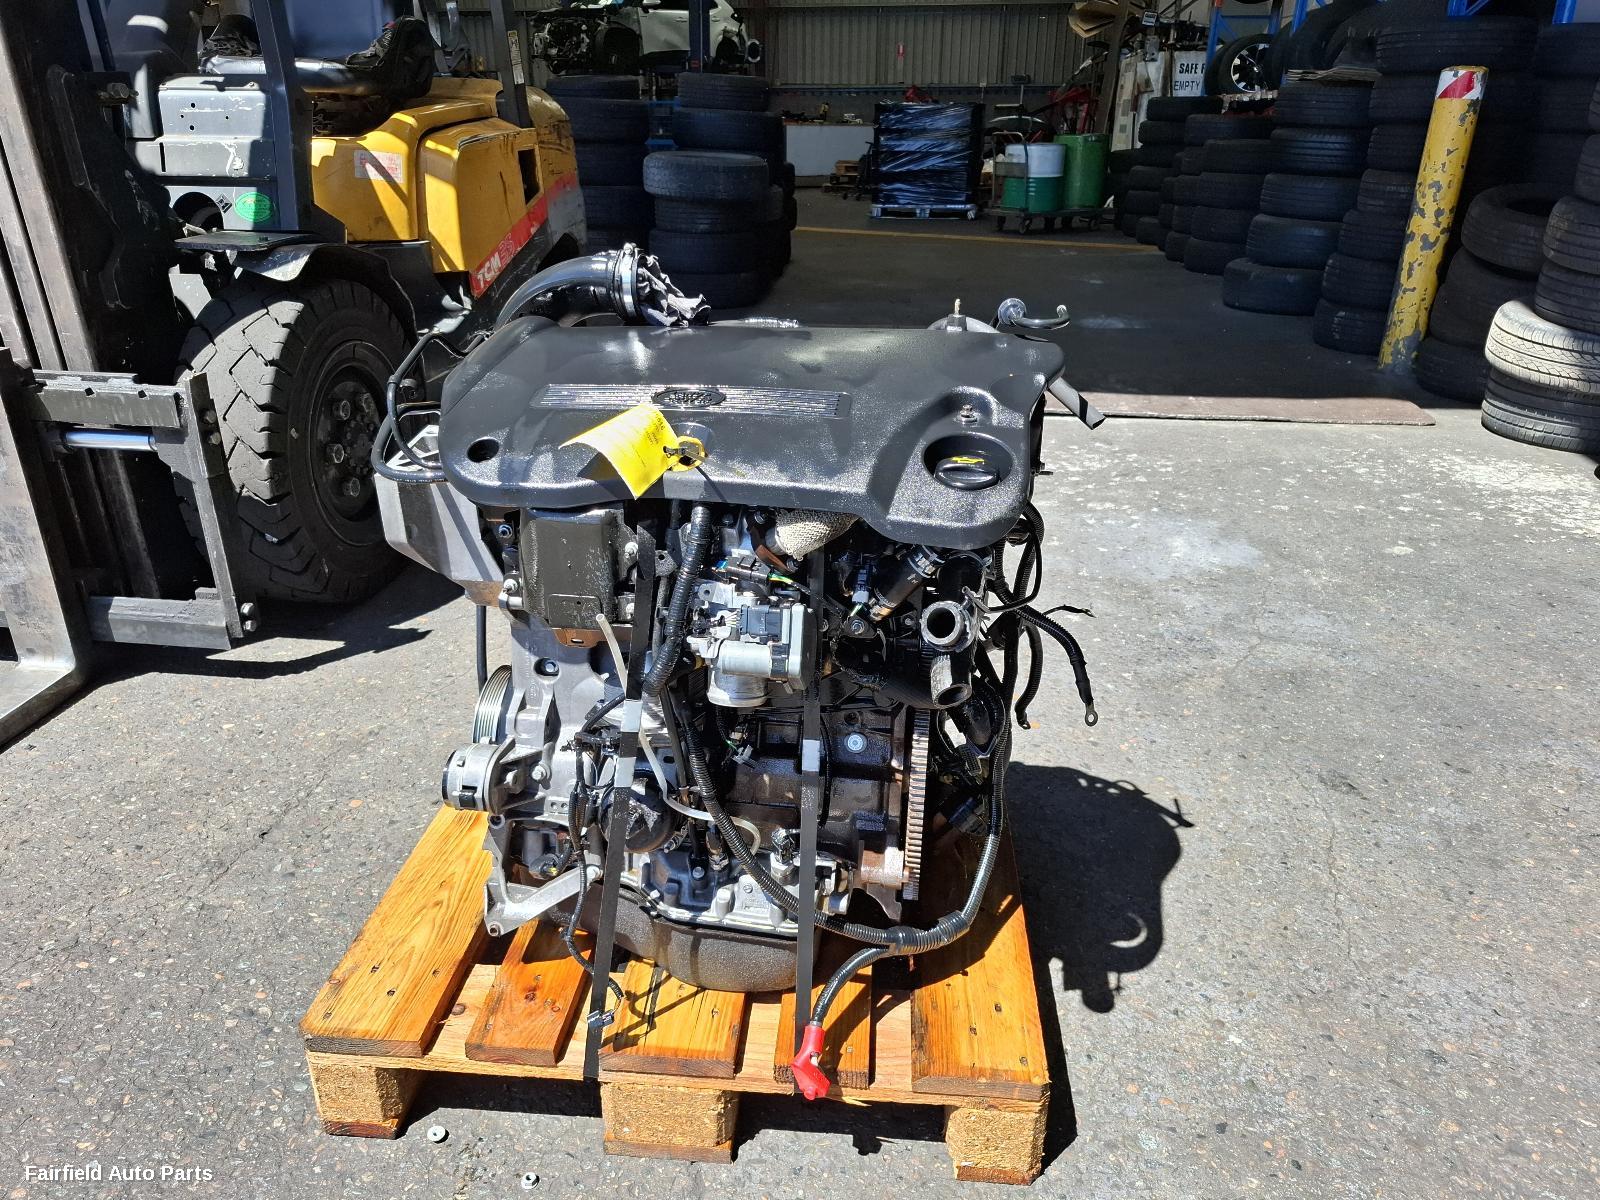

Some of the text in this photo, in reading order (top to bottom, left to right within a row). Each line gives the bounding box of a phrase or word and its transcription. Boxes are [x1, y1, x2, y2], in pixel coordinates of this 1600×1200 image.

[1179, 63, 1199, 75] SAFE
[1173, 80, 1200, 91] EMPTY
[477, 252, 501, 289] TCM
